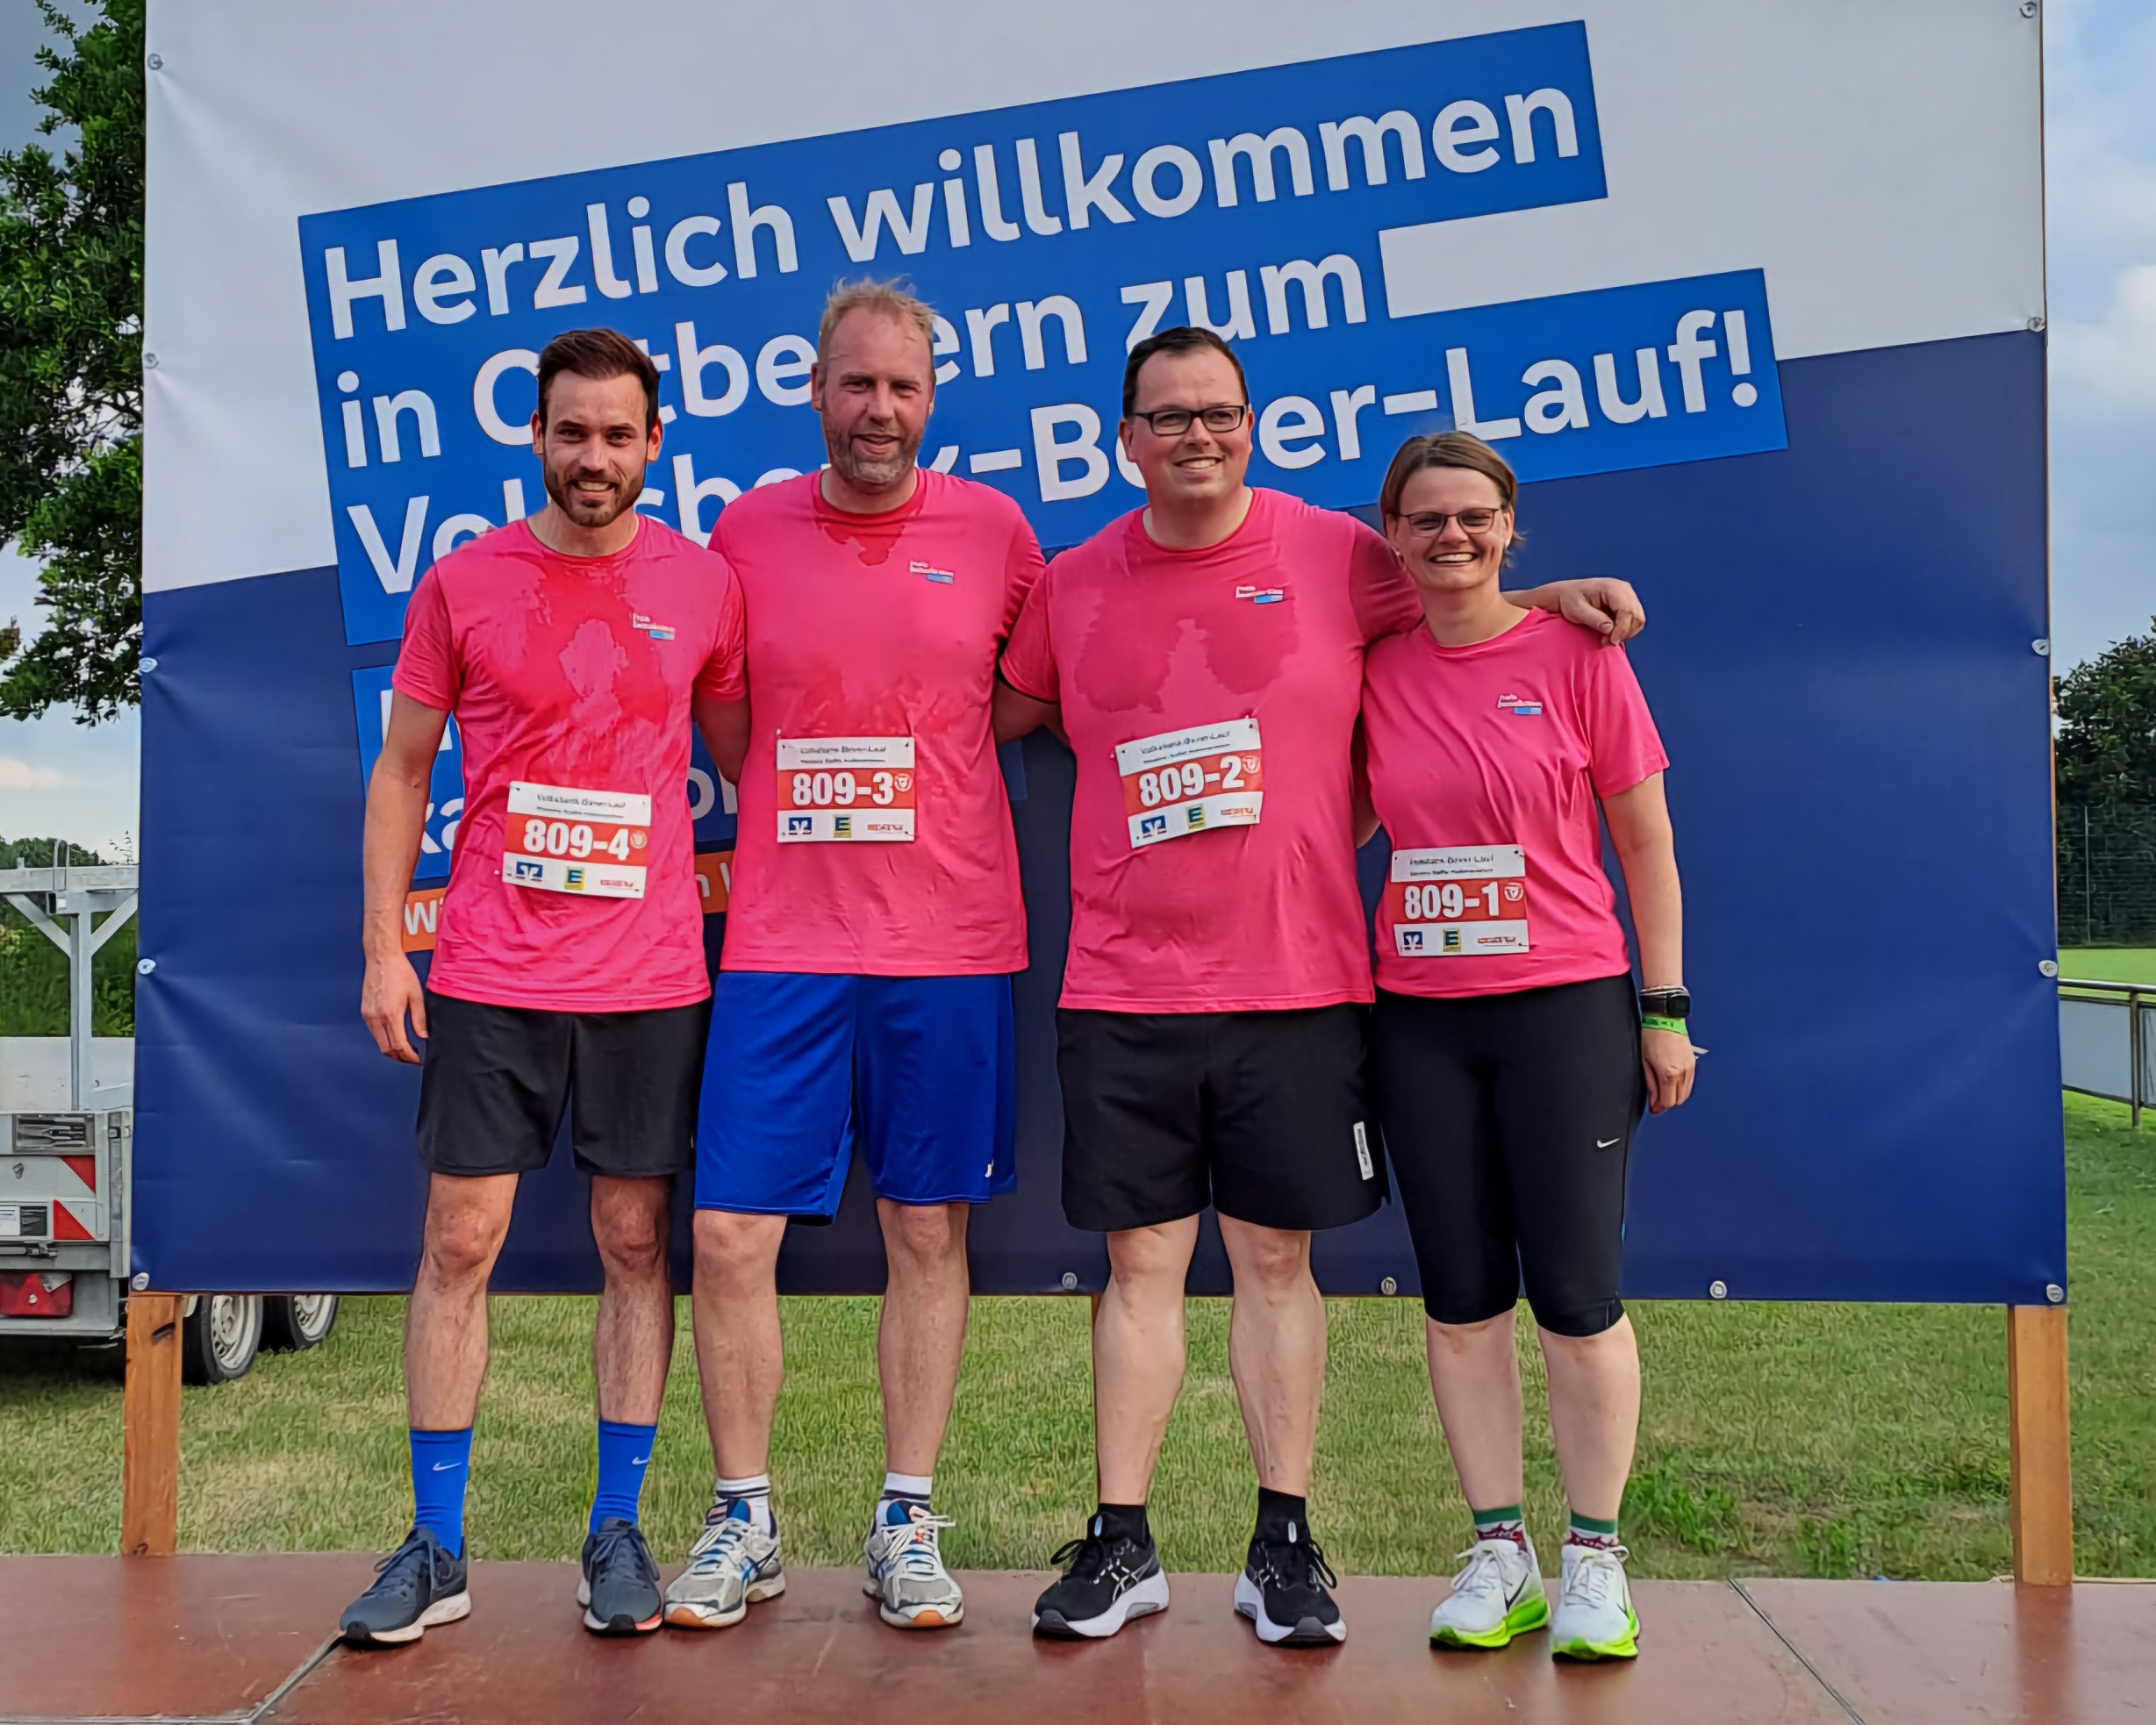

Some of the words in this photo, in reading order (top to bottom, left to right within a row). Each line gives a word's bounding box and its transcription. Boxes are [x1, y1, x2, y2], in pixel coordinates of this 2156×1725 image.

[324, 181, 799, 340] Herzlich
[827, 87, 1579, 264] willkommen
[337, 370, 441, 469] in
[472, 295, 1088, 446] Otbeern
[1120, 253, 1366, 356] zum
[347, 309, 1758, 595] Vb-Ber-Lauf!
[792, 771, 894, 805] 809-3
[1139, 755, 1245, 807] 809-2
[523, 819, 630, 861] 809-4
[1404, 881, 1500, 920] 809-1
